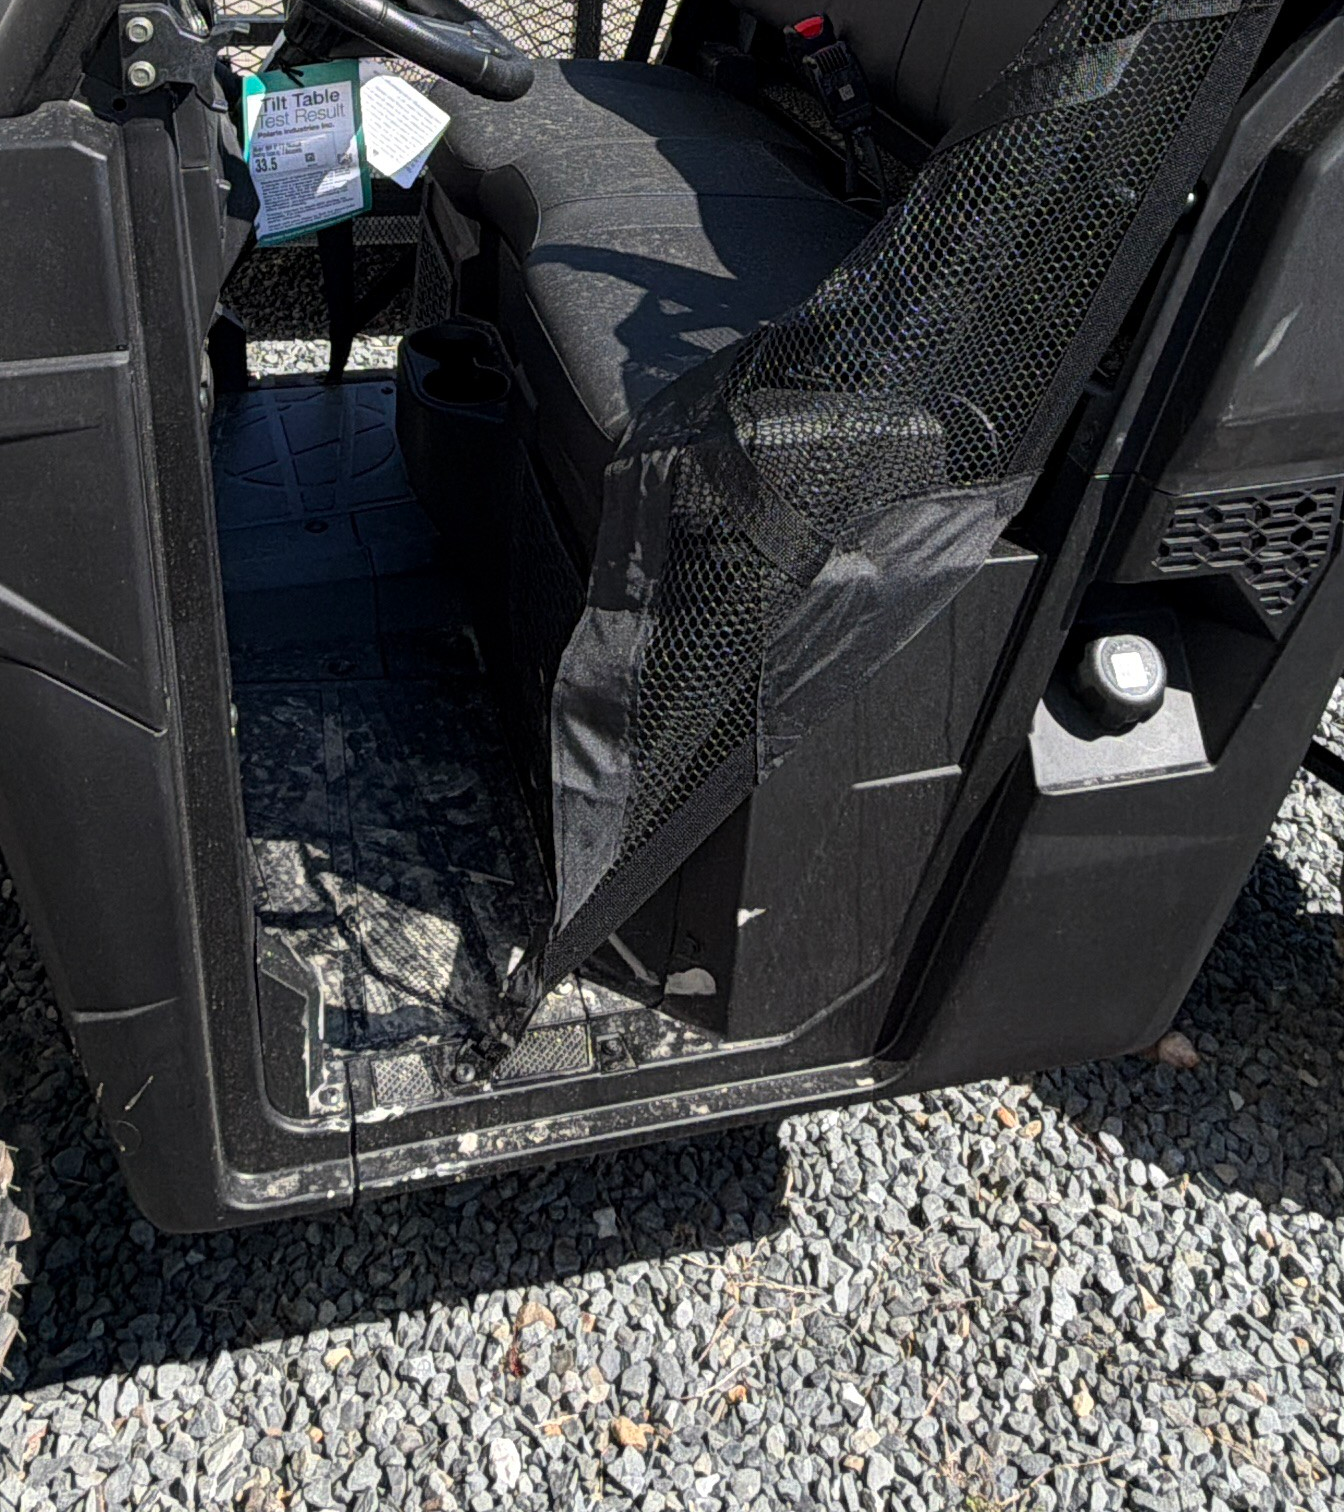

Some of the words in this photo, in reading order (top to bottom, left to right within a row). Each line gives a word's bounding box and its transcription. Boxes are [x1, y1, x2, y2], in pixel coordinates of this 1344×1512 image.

[260, 96, 288, 113] Tilt
[292, 88, 340, 108] Table
[258, 111, 290, 130] Test
[295, 102, 346, 125] Result
[254, 156, 278, 173] 33.5
